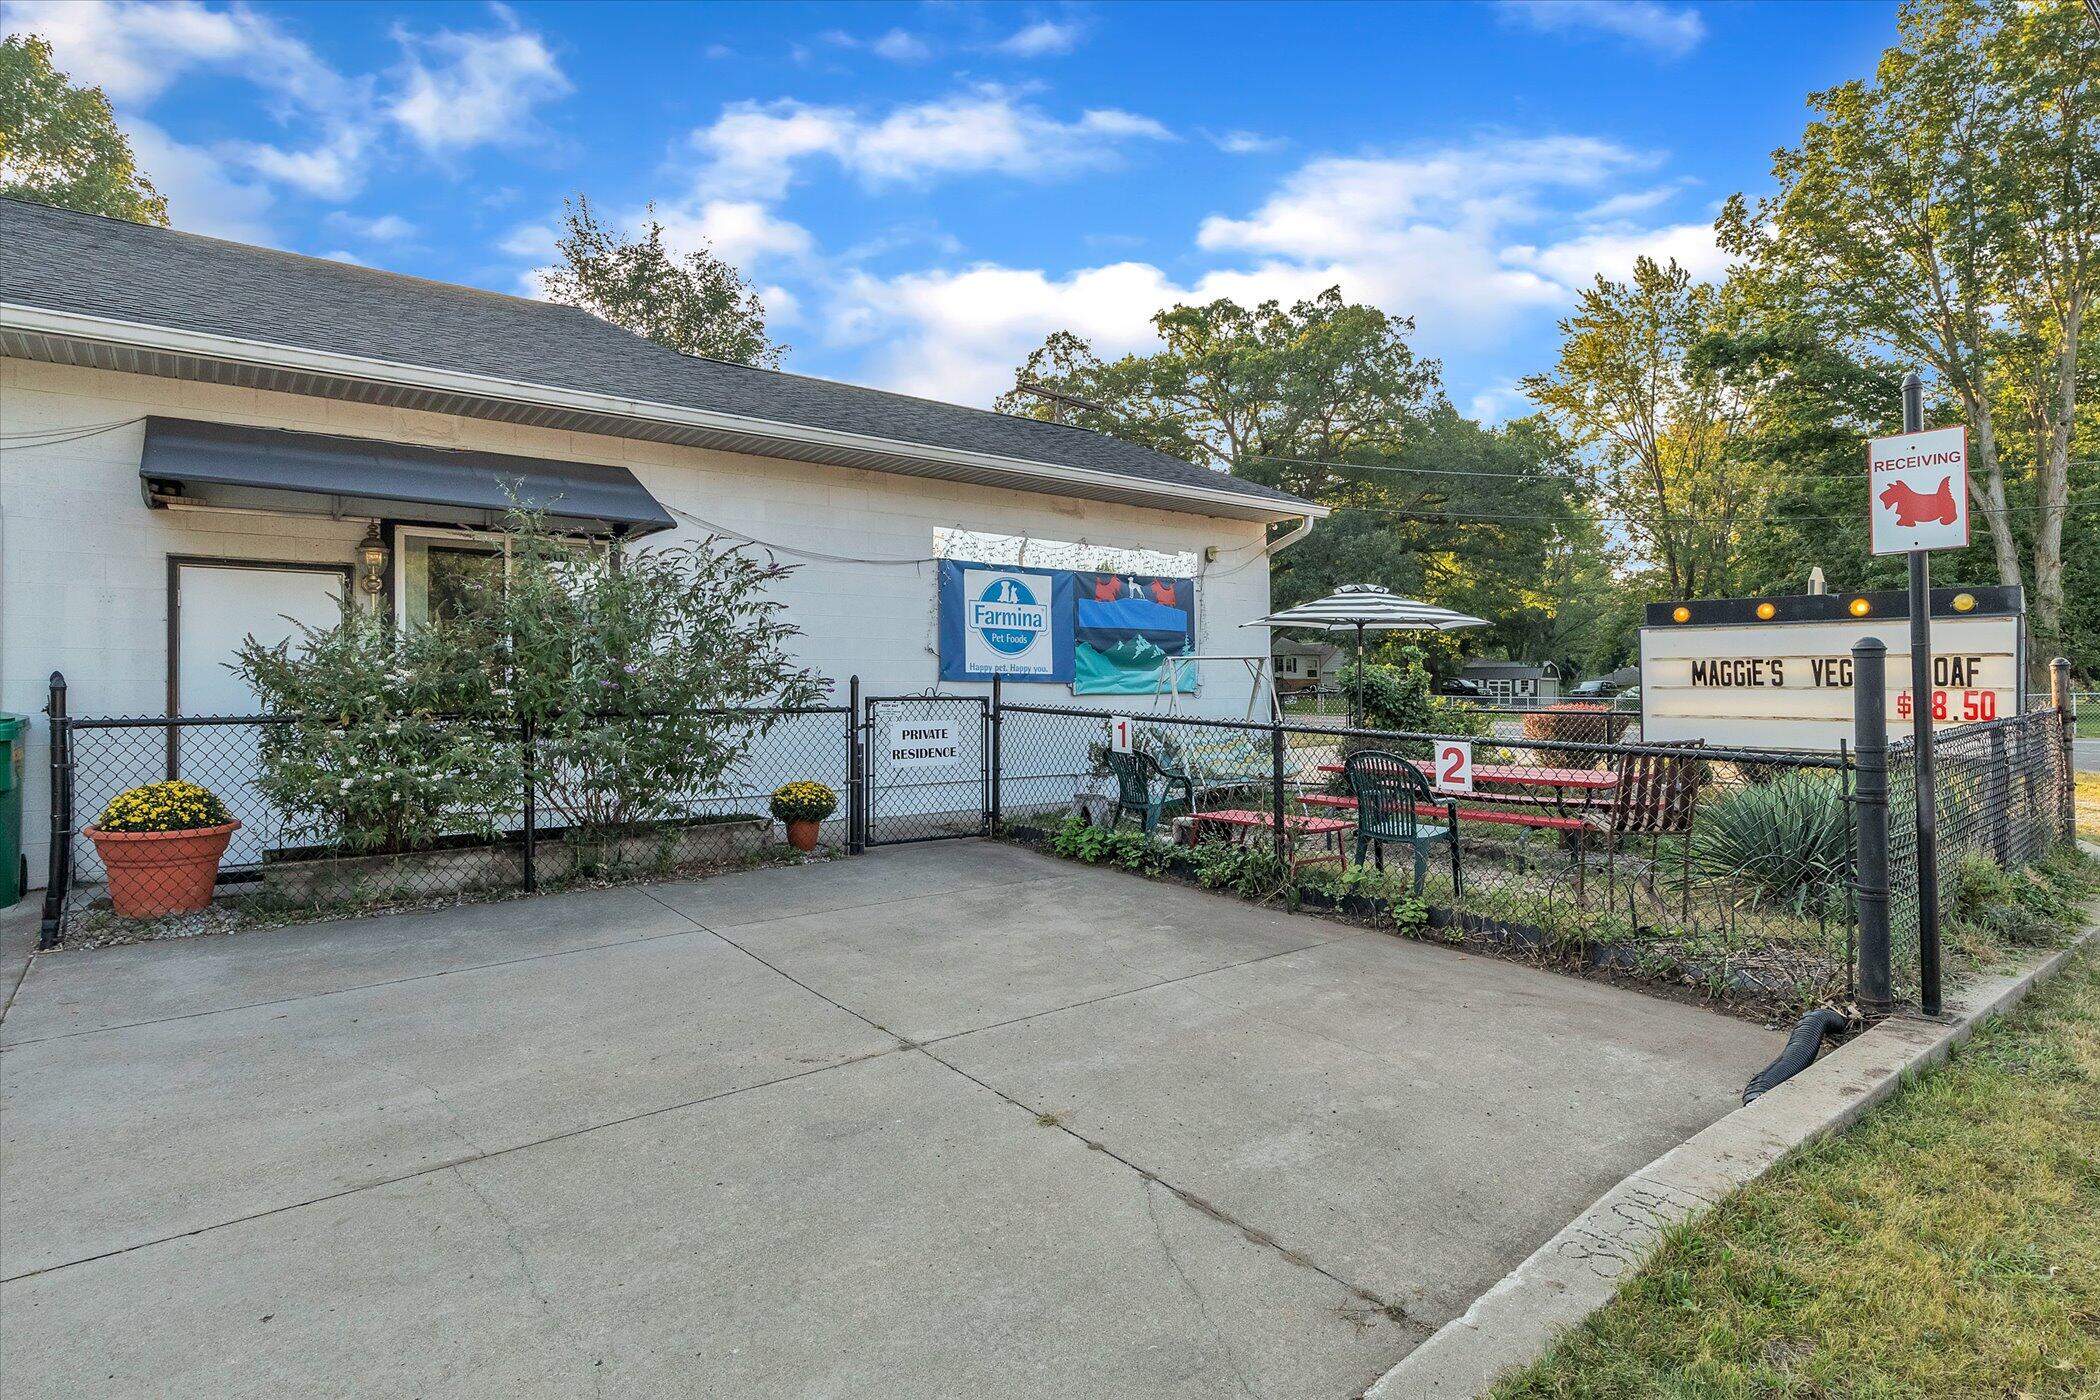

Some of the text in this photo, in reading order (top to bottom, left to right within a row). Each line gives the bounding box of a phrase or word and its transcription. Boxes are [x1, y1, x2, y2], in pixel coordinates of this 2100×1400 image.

[1874, 451, 1961, 472] RECEIVING
[975, 605, 1042, 628] Farmina
[992, 633, 1028, 643] Pet Foods
[969, 663, 1048, 674] Happy pet. Happy you.
[1811, 658, 1853, 687] VEG
[1934, 656, 1981, 687] OAF
[902, 728, 948, 740] PRIVATE
[1117, 721, 1126, 748] 1
[892, 746, 957, 760] RESIDENCE
[1442, 746, 1466, 784] 2
